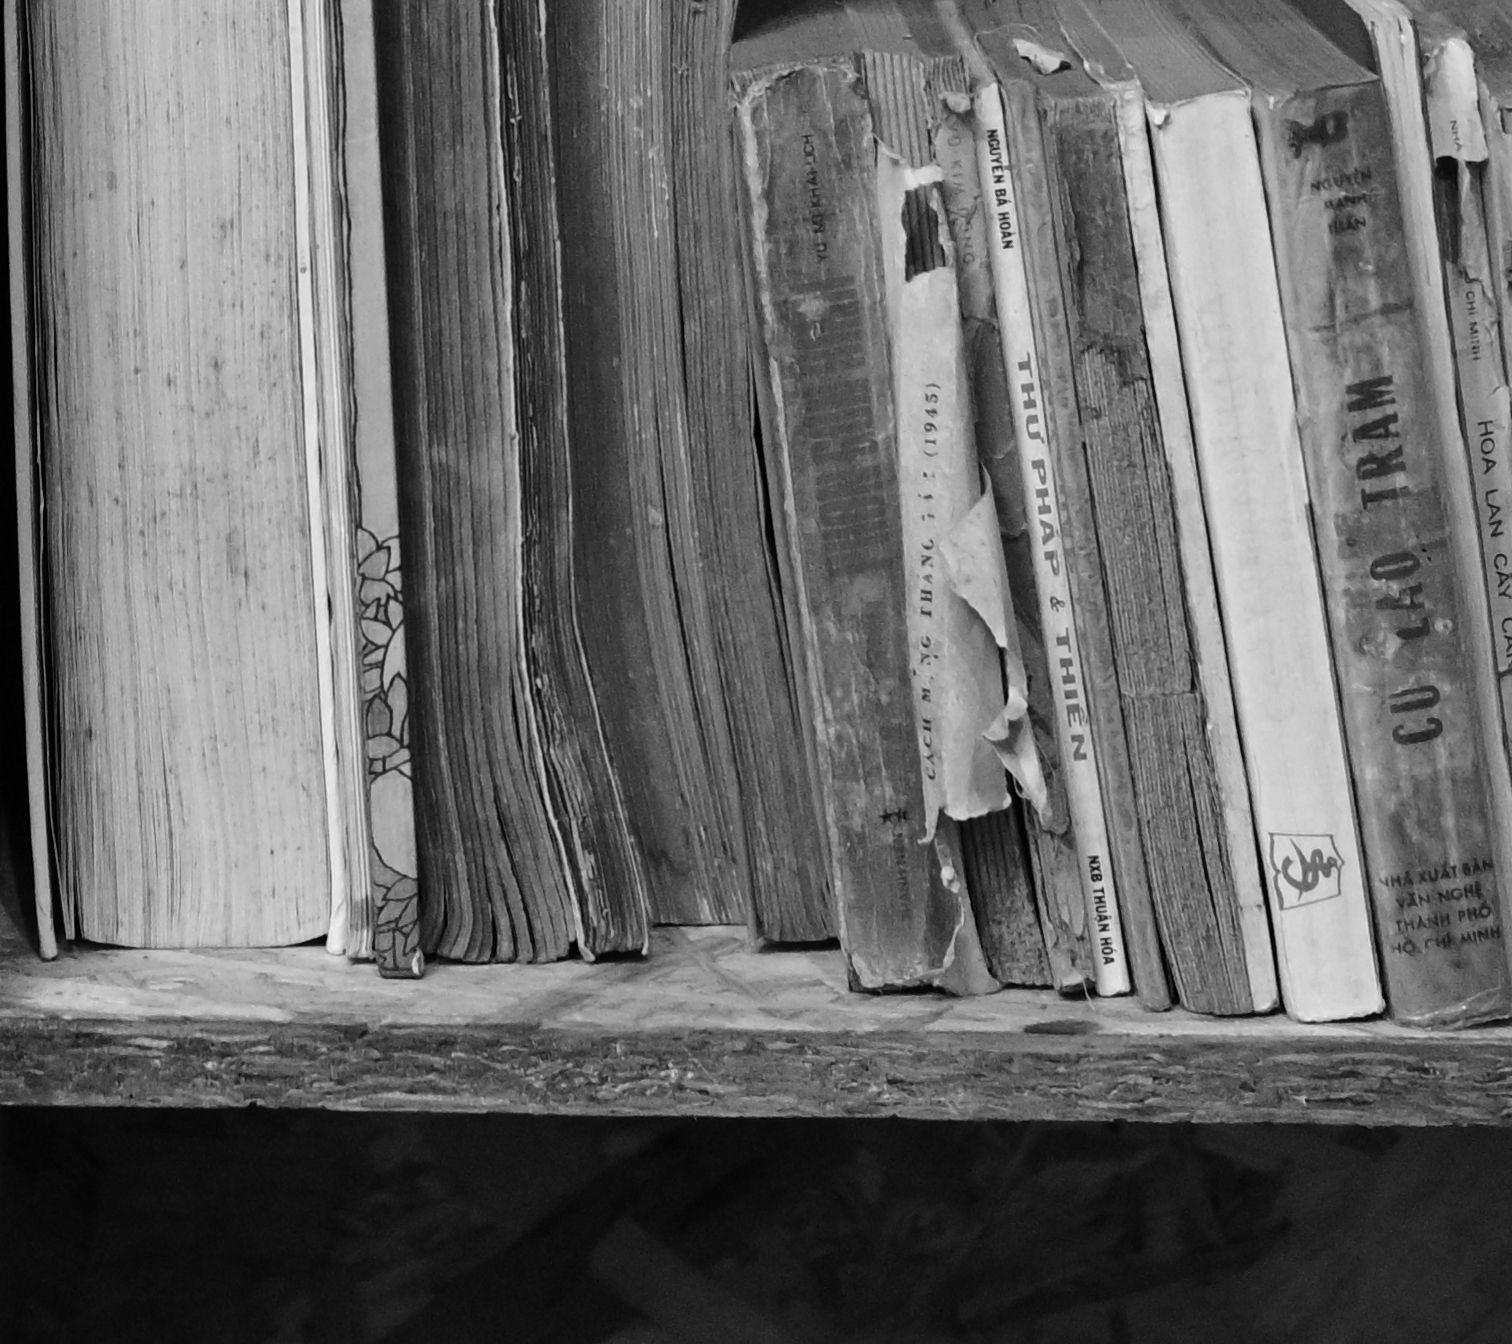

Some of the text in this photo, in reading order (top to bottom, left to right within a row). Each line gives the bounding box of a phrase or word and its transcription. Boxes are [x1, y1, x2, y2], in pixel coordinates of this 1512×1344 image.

[992, 185, 1015, 209] BÁ
[995, 210, 1019, 250] HOÀN
[1477, 420, 1496, 475] HOA
[1018, 352, 1045, 444] THƯ
[1049, 596, 1065, 612] &
[1485, 488, 1504, 538] LAN
[1493, 553, 1512, 599] CÂY
[1087, 855, 1115, 965] NXB THUẬN HÓA
